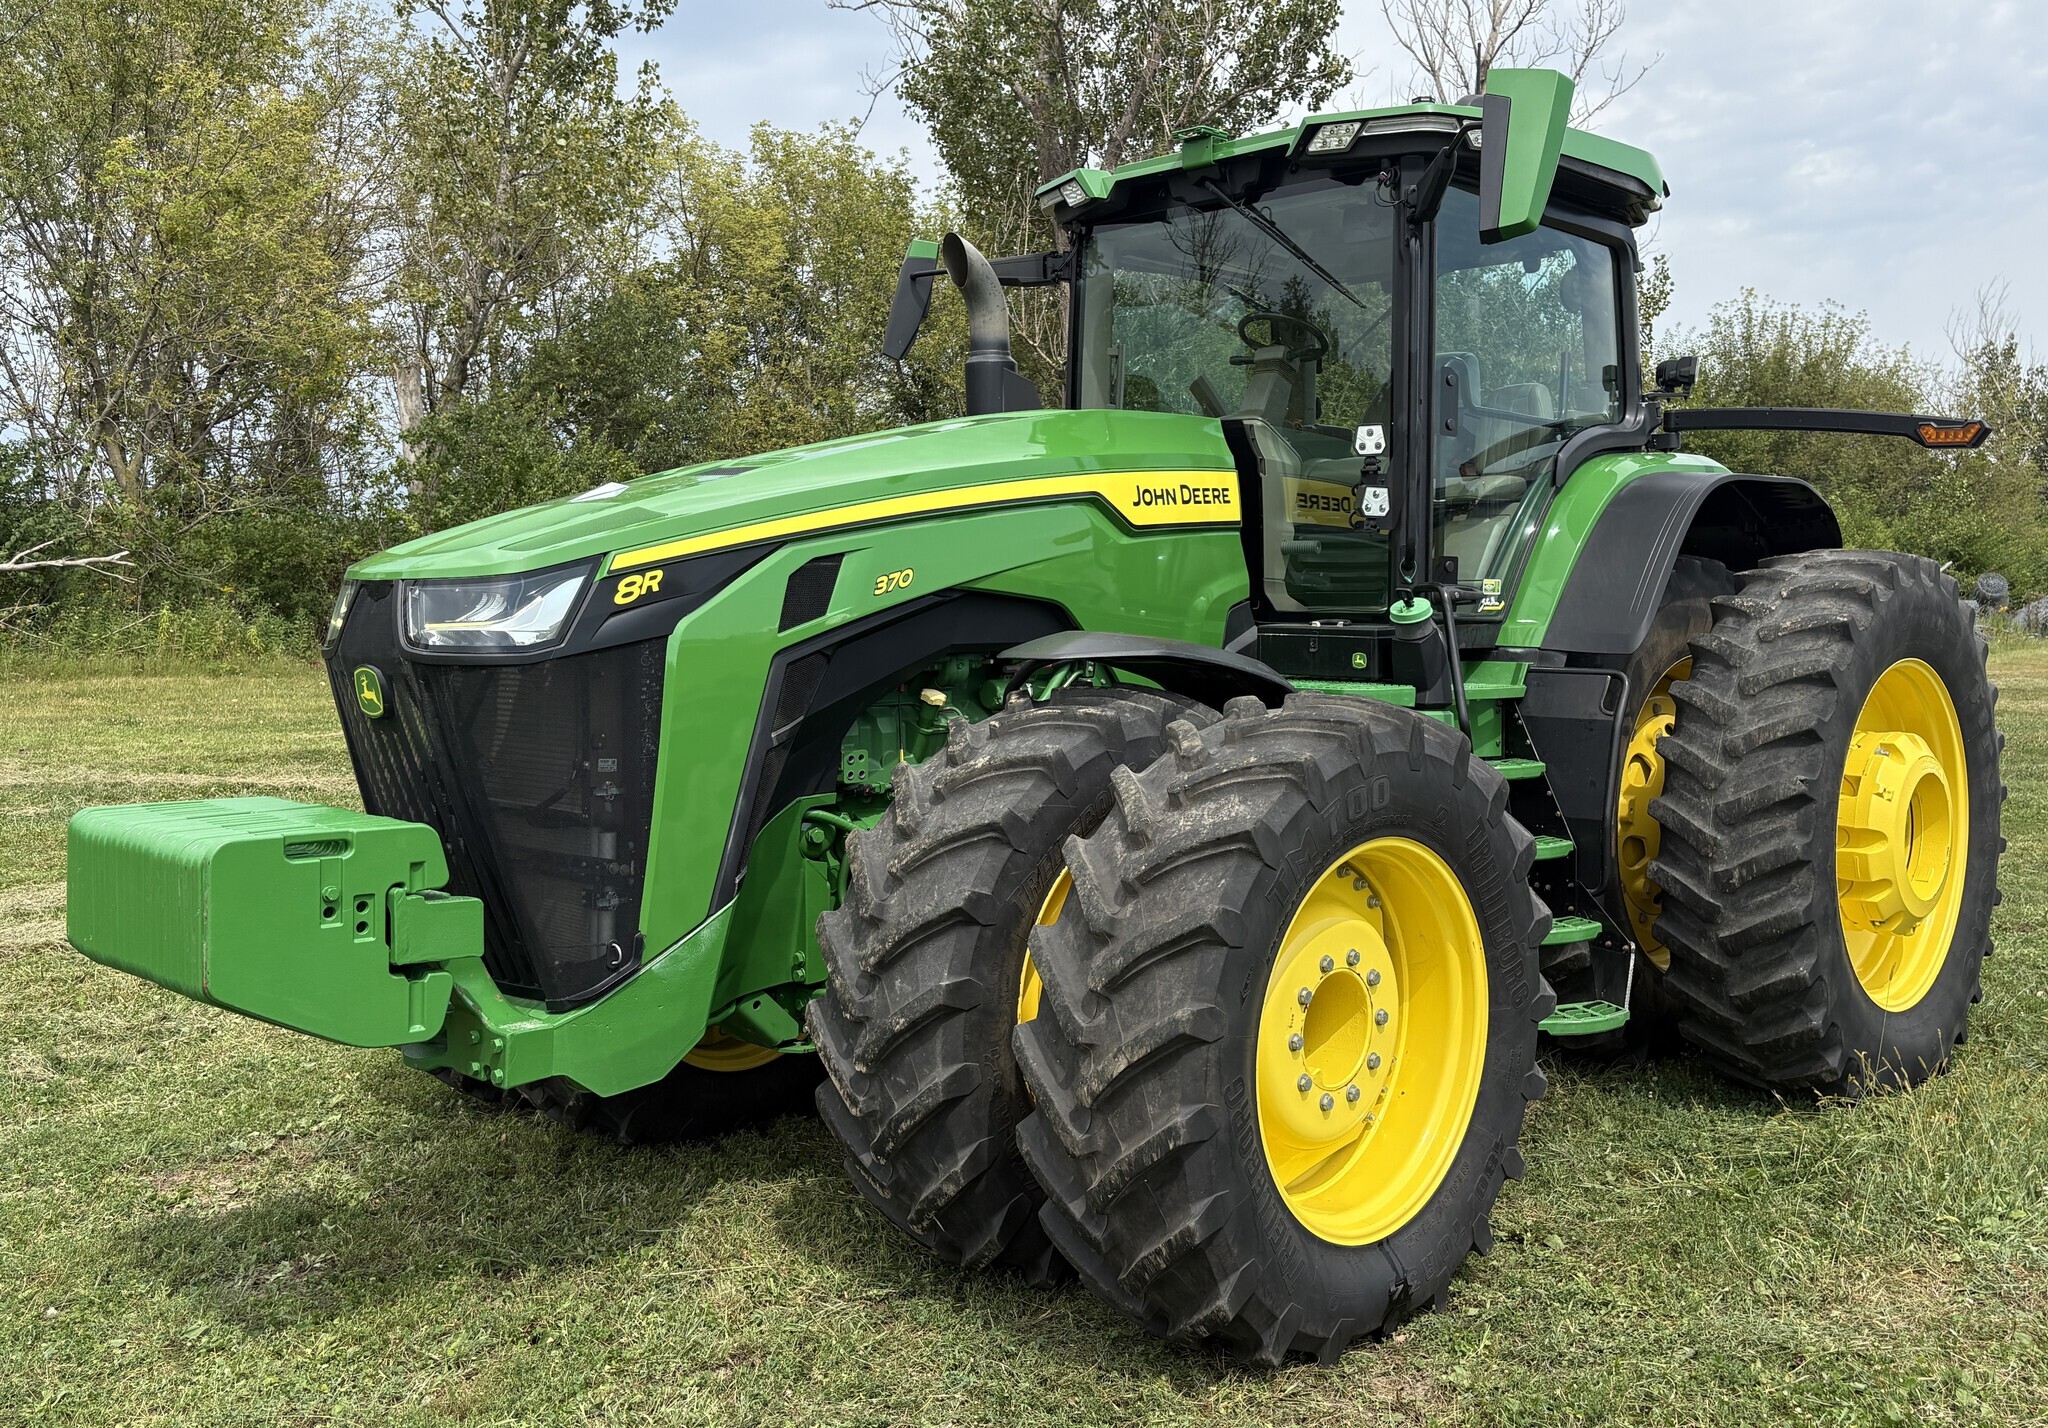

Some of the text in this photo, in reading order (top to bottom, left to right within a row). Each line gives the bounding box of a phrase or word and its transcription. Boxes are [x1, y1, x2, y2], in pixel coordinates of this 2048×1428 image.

[1133, 484, 1231, 507] JOHN DEERE
[613, 569, 664, 605] 8R
[873, 567, 914, 596] 370
[1465, 814, 1531, 1007] TRELLEBORG
[1224, 1075, 1306, 1296] TRELLEBORG
[1389, 1130, 1505, 1294] 480/70R3
